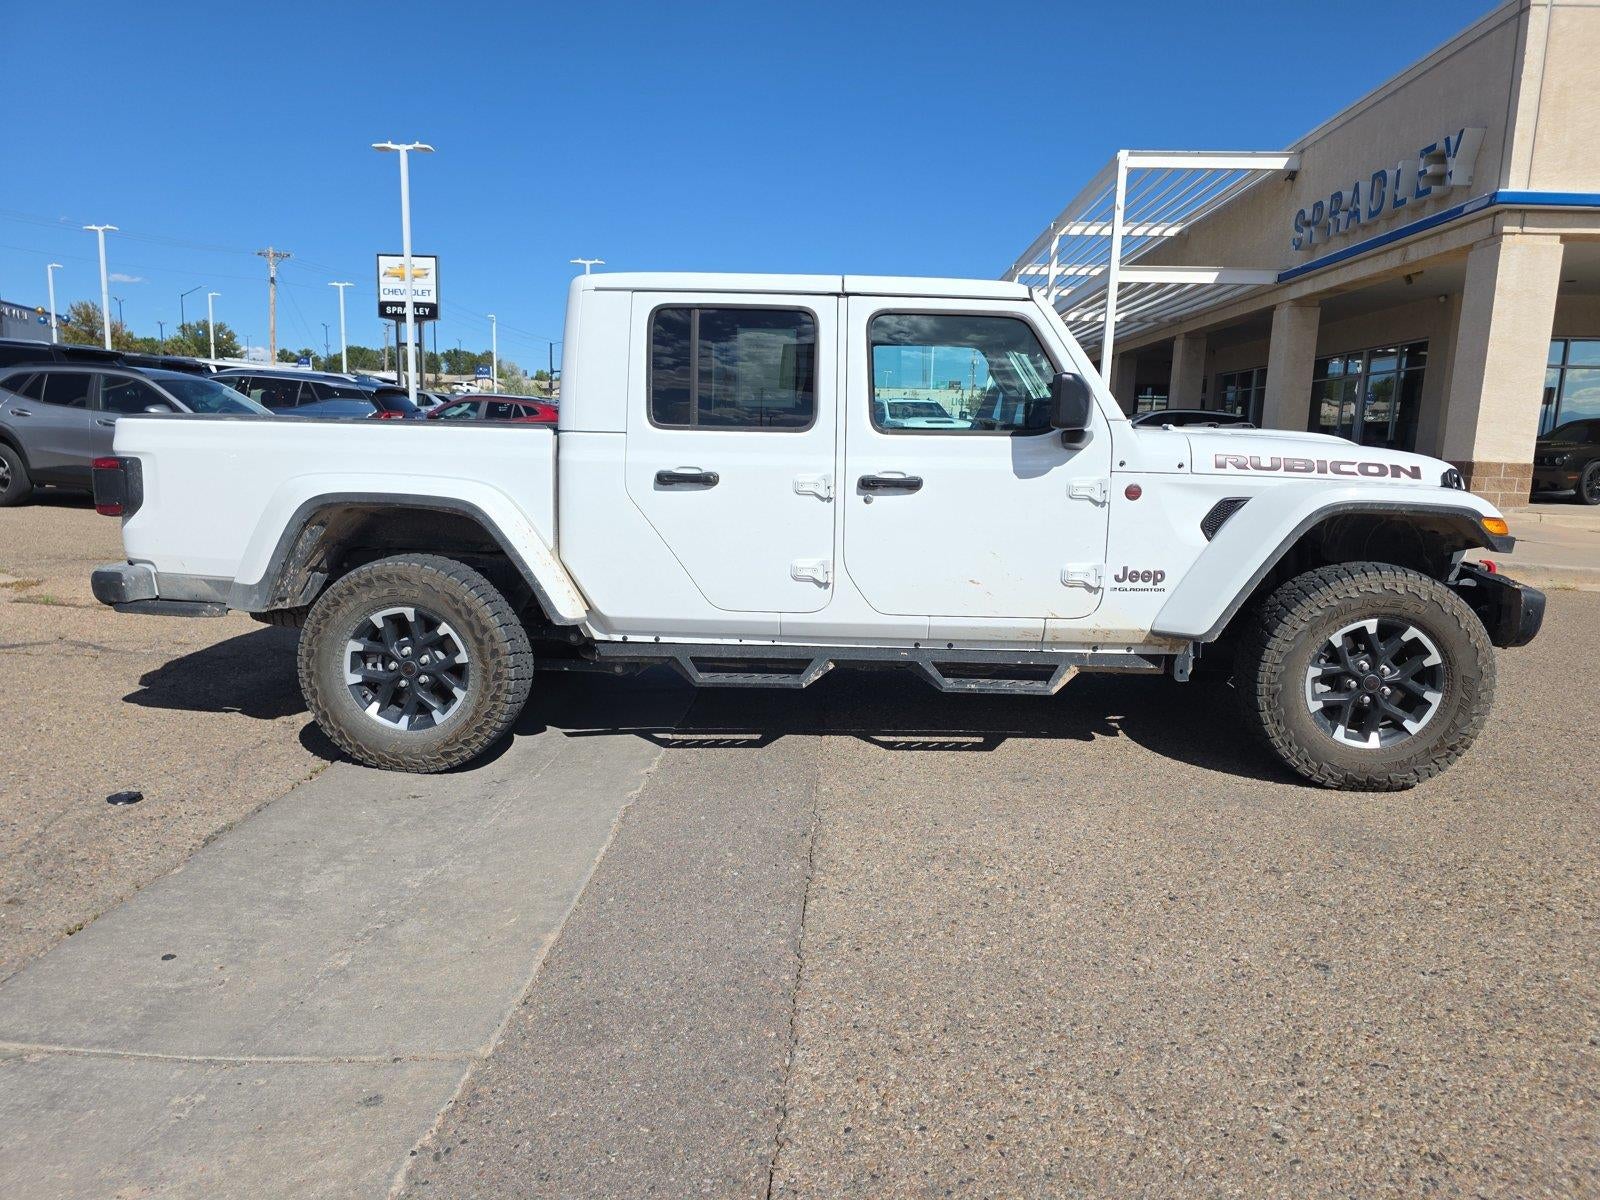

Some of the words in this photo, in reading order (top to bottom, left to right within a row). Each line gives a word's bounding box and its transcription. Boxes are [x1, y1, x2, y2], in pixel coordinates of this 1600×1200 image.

[1292, 127, 1468, 251] SPRADLEY
[383, 288, 431, 296] CHEVOLET
[386, 306, 430, 315] SPRALEY
[1214, 453, 1422, 480] RUBICON
[1113, 566, 1166, 586] Jeep
